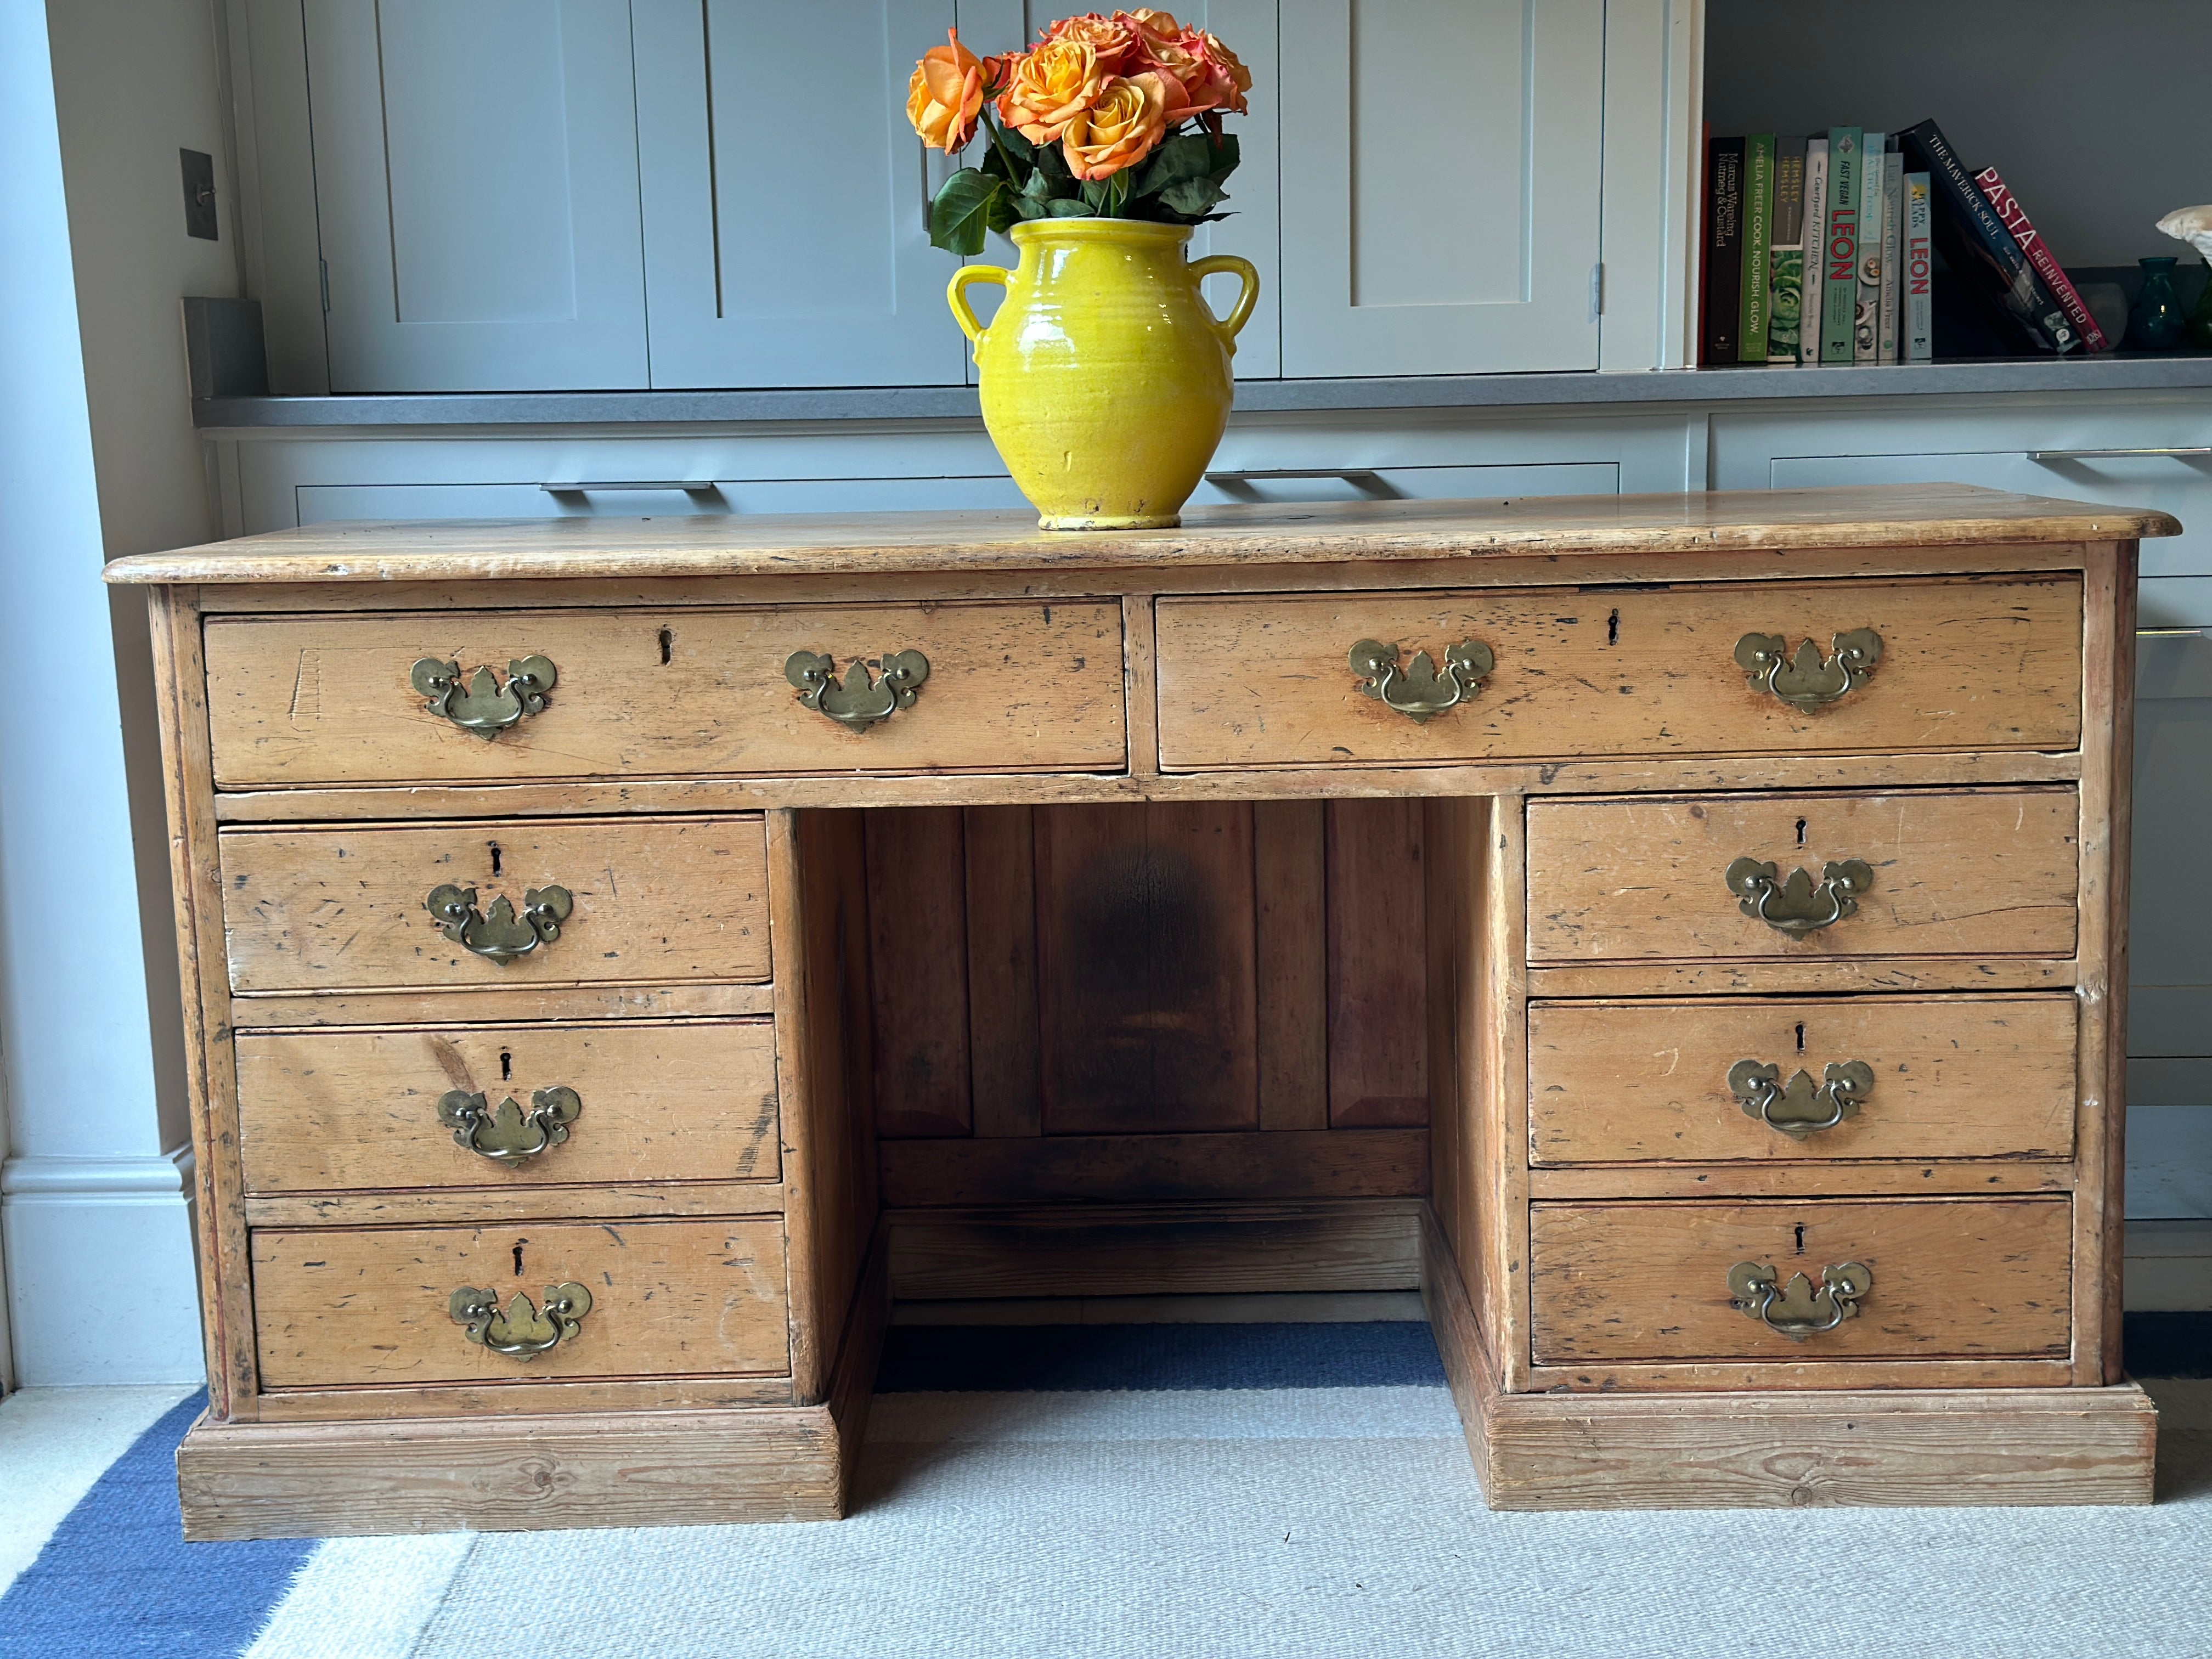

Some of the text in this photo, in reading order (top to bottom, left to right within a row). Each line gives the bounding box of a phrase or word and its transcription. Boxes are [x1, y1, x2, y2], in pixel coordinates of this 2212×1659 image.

[1755, 143, 1764, 180] AMELIA
[1781, 156, 1790, 202] HEMSLEY
[1791, 156, 1800, 202] HEMSLEY
[1840, 160, 1850, 179] FAST
[1716, 153, 1728, 247] Nutmeg & Custard
[1726, 153, 1739, 237] Marcus Wareing
[1754, 182, 1764, 214] FREER
[1839, 179, 1850, 206] VEGAN
[1911, 191, 1919, 228] SALADS
[1929, 134, 2000, 240] THE MAVERICK SOUL
[1830, 210, 1855, 280] LEON
[1910, 237, 1929, 295] LEON
[1974, 166, 2037, 251] PASTA
[2032, 249, 2087, 324] REINVENTED
[1749, 301, 1760, 336] GLOW.
